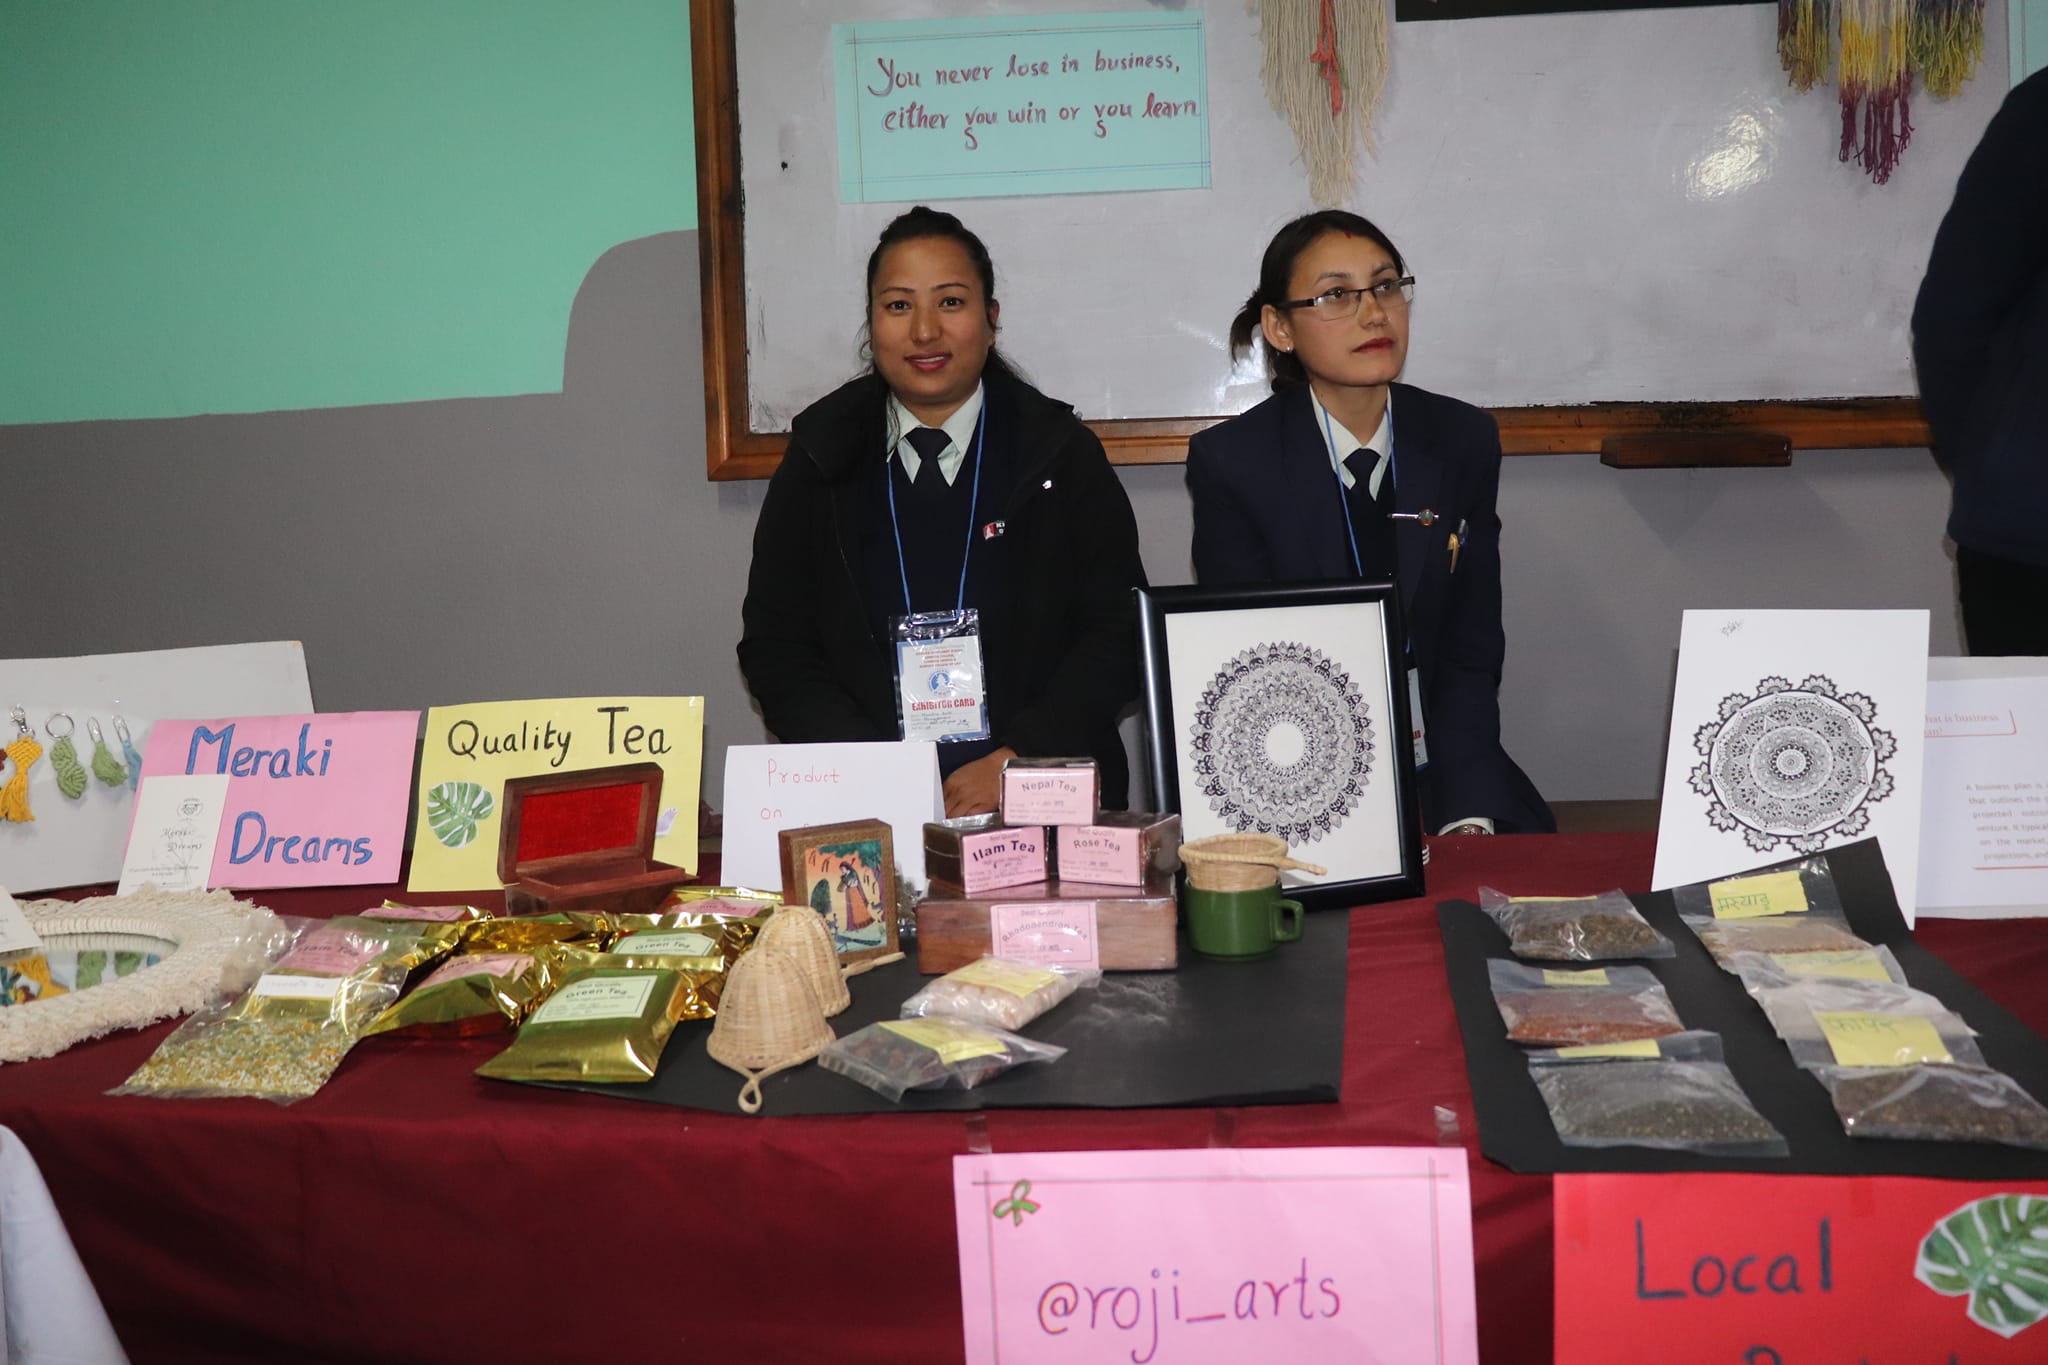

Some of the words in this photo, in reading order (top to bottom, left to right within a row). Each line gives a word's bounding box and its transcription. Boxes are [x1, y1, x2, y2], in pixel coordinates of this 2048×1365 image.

[868, 58, 921, 96] You
[936, 65, 994, 86] never
[1006, 54, 1049, 78] lose
[1061, 54, 1079, 73] in
[1095, 50, 1181, 74] business,
[884, 102, 950, 133] either
[964, 106, 998, 151] you
[1008, 101, 1046, 124] win
[1059, 106, 1080, 120] or
[1094, 102, 1132, 138] you
[1143, 93, 1199, 118] learn
[954, 698, 975, 708] CARD
[186, 722, 334, 777] Meraki
[447, 719, 573, 767] Quality
[598, 706, 673, 755] Tea
[767, 758, 840, 787] Product
[1022, 780, 1054, 792] Nepal
[1059, 780, 1077, 793] Tea
[230, 811, 373, 867] Dreams
[1011, 840, 1036, 853] Tea
[1073, 839, 1100, 849] Rose
[1104, 839, 1121, 852] Tea
[635, 942, 669, 950] Green
[674, 940, 691, 949] Tea
[566, 988, 603, 998] Green
[609, 987, 627, 996] Tea
[1636, 1217, 1833, 1300] Local
[1038, 1257, 1341, 1364] @roji_arts
